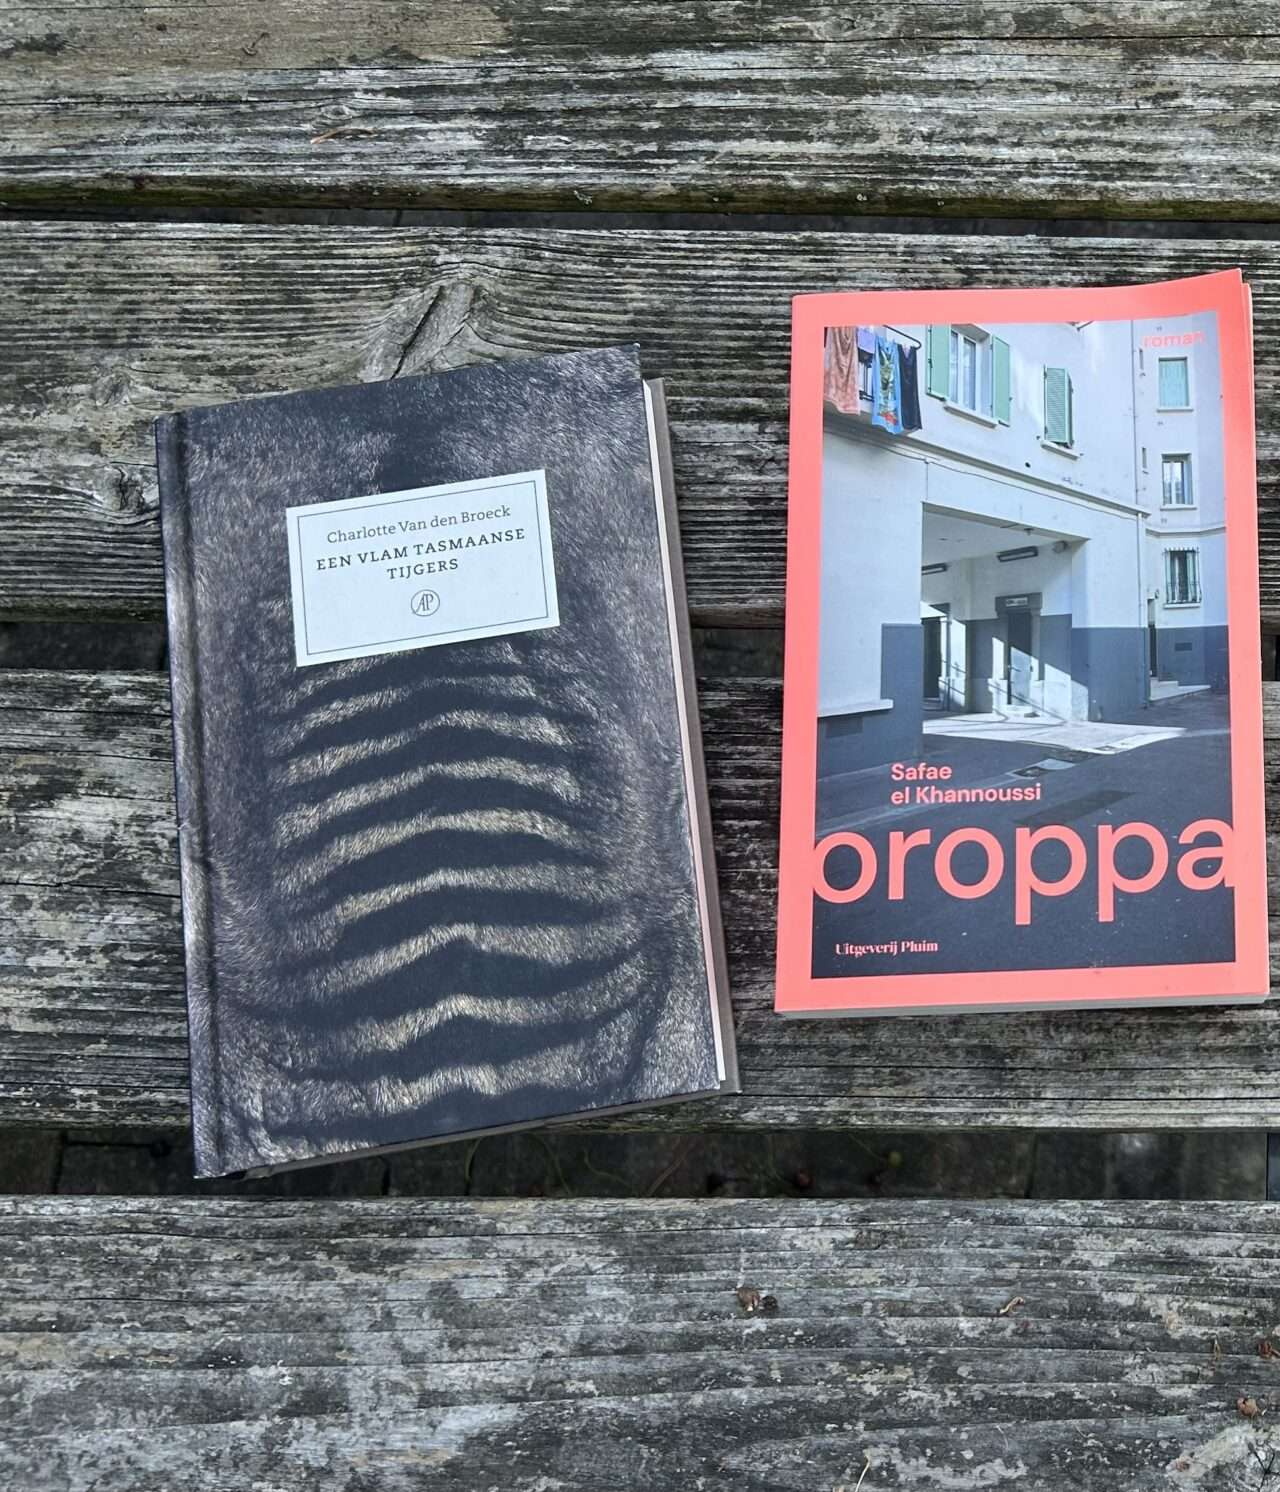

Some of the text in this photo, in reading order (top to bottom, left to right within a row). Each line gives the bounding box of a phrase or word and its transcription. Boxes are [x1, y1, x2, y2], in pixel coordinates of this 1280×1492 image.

[1143, 331, 1205, 347] roman
[326, 504, 512, 545] Charlotte Van den Broeck
[316, 527, 526, 571] EEN VLAM TASMAANSE
[386, 558, 460, 580] TIJGERS
[891, 762, 953, 782] Safae
[891, 782, 1042, 805] el Khannoussi
[812, 818, 1235, 926] oroppa
[835, 939, 939, 958] Uitgeverij Pluim
